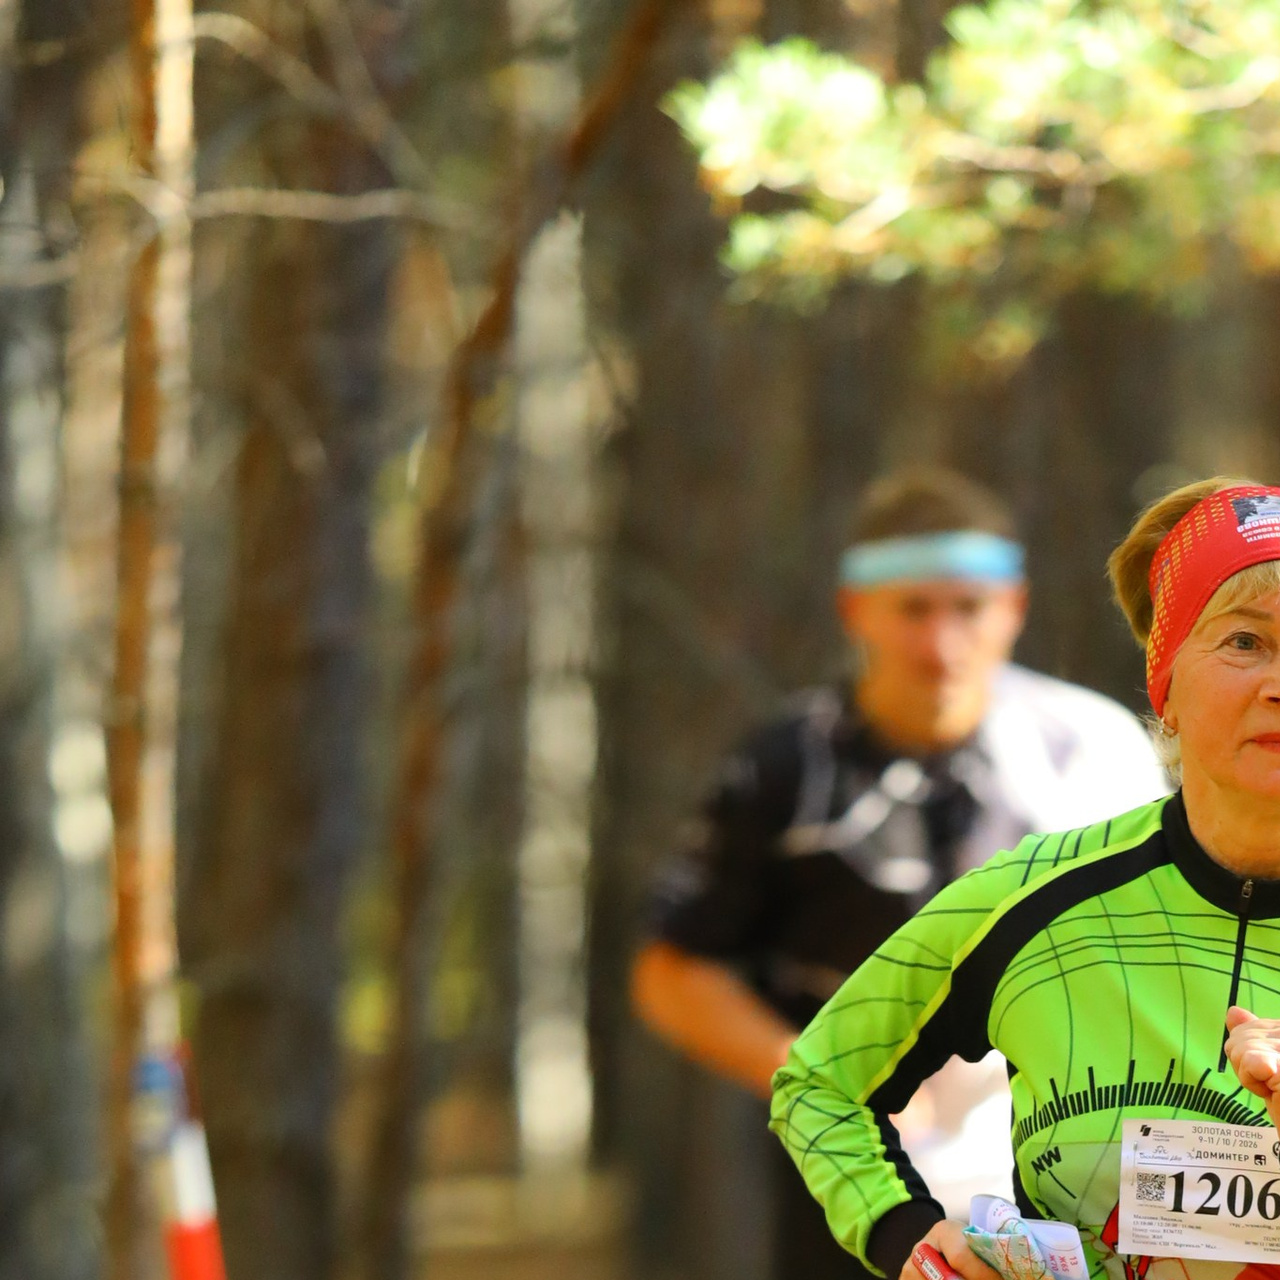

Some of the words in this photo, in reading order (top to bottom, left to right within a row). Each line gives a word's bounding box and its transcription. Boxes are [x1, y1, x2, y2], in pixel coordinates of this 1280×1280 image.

[1191, 1125, 1231, 1137] ЗОЛОТАЯ
[1234, 1128, 1263, 1140] ОСЕНЬ
[1238, 1139, 1258, 1149] 2026
[1031, 1146, 1062, 1176] NW
[1195, 1150, 1250, 1162] ДОМИНТЕР
[1070, 1256, 1078, 1266] 13
